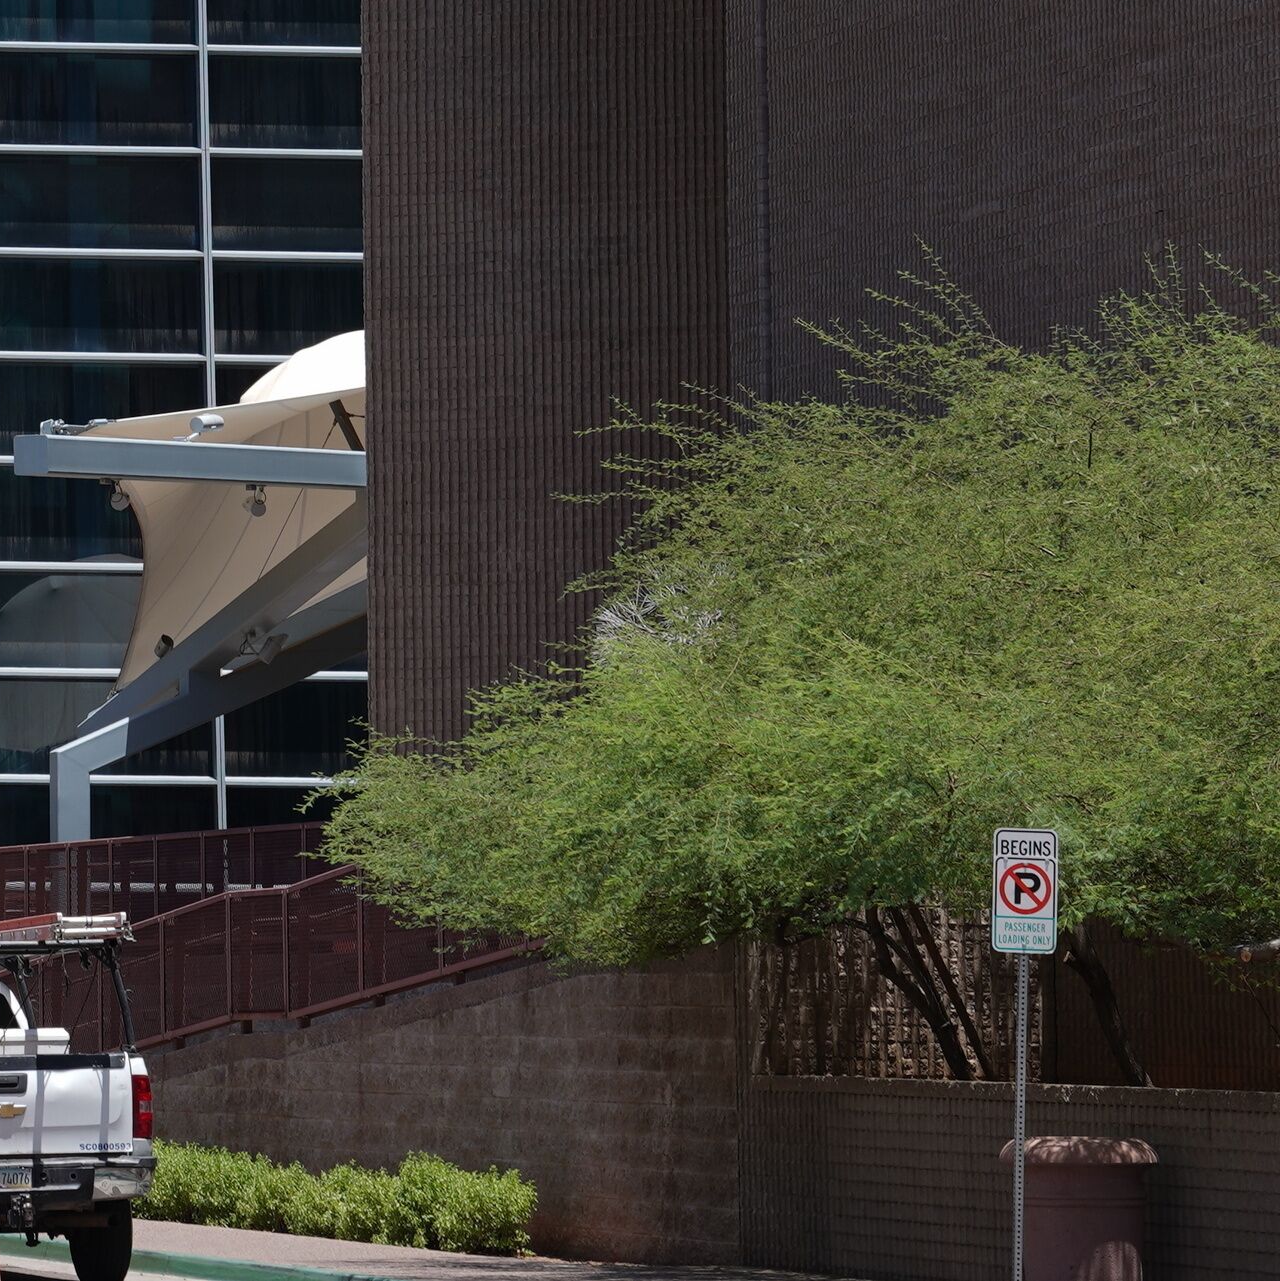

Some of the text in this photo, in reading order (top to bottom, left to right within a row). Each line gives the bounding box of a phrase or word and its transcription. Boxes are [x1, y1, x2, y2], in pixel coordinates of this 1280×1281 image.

[1000, 839, 1051, 857] BEGINS
[1004, 921, 1046, 933] PASSENGER
[998, 934, 1051, 946] LOADING ONLY
